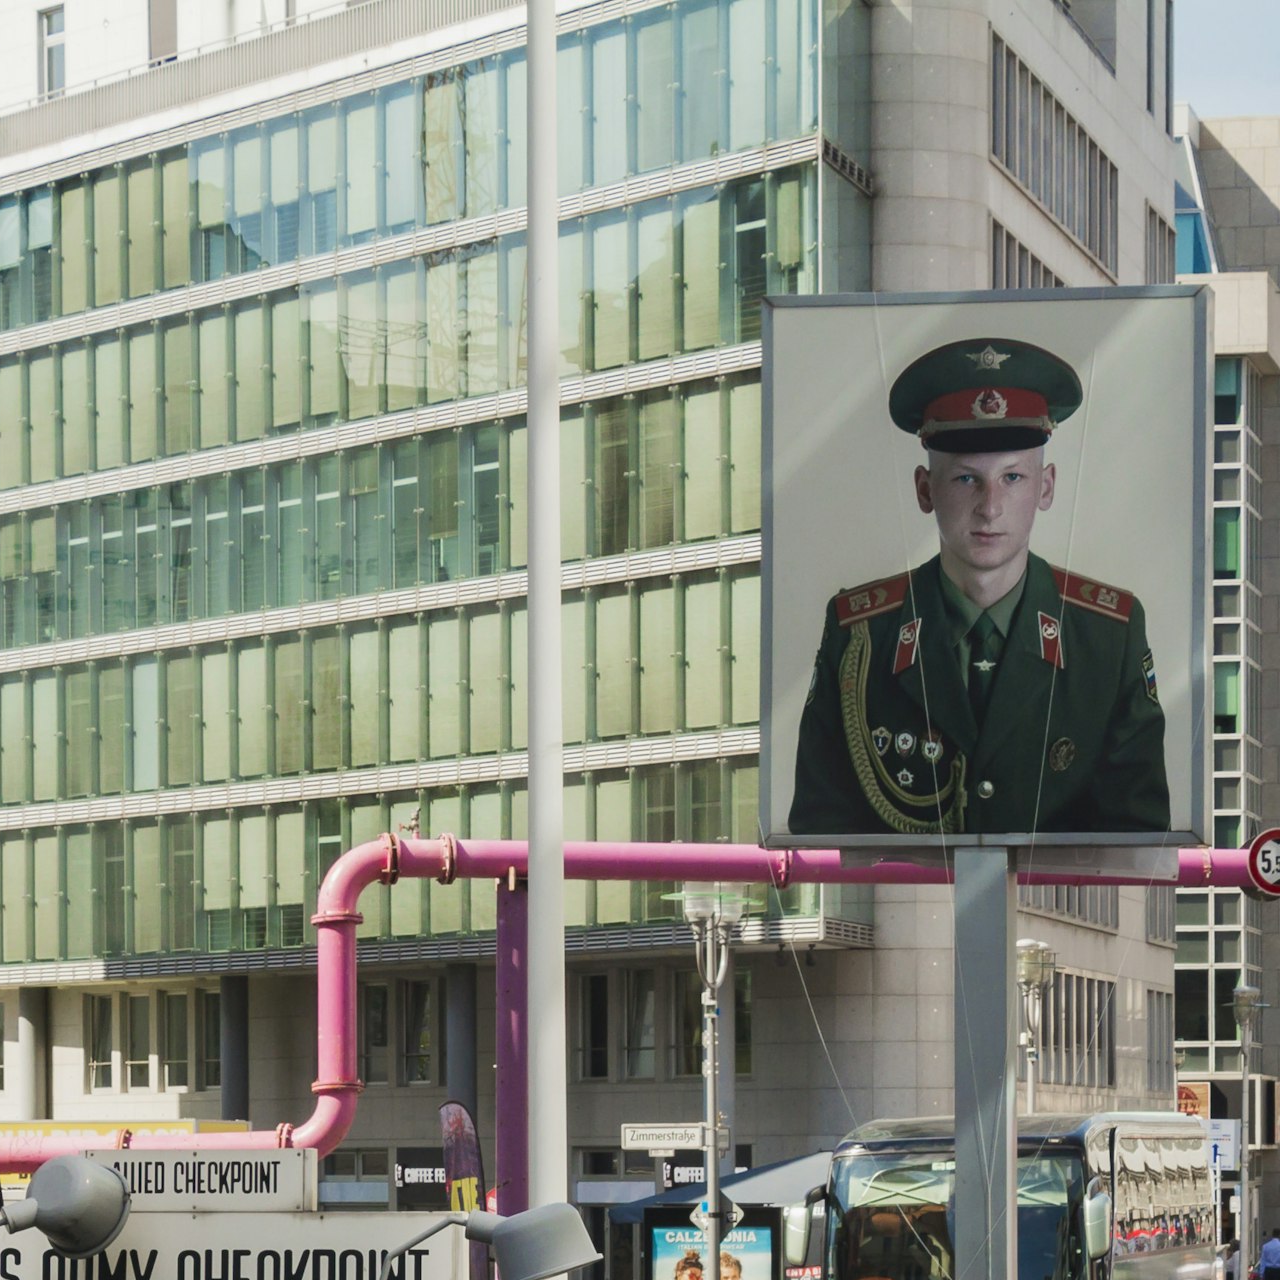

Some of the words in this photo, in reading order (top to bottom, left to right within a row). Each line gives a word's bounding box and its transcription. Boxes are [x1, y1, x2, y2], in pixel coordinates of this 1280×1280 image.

[630, 1130, 696, 1143] Zimmerstraße
[174, 1161, 281, 1194] CHECKPOINT
[404, 1168, 434, 1184] COFFEE
